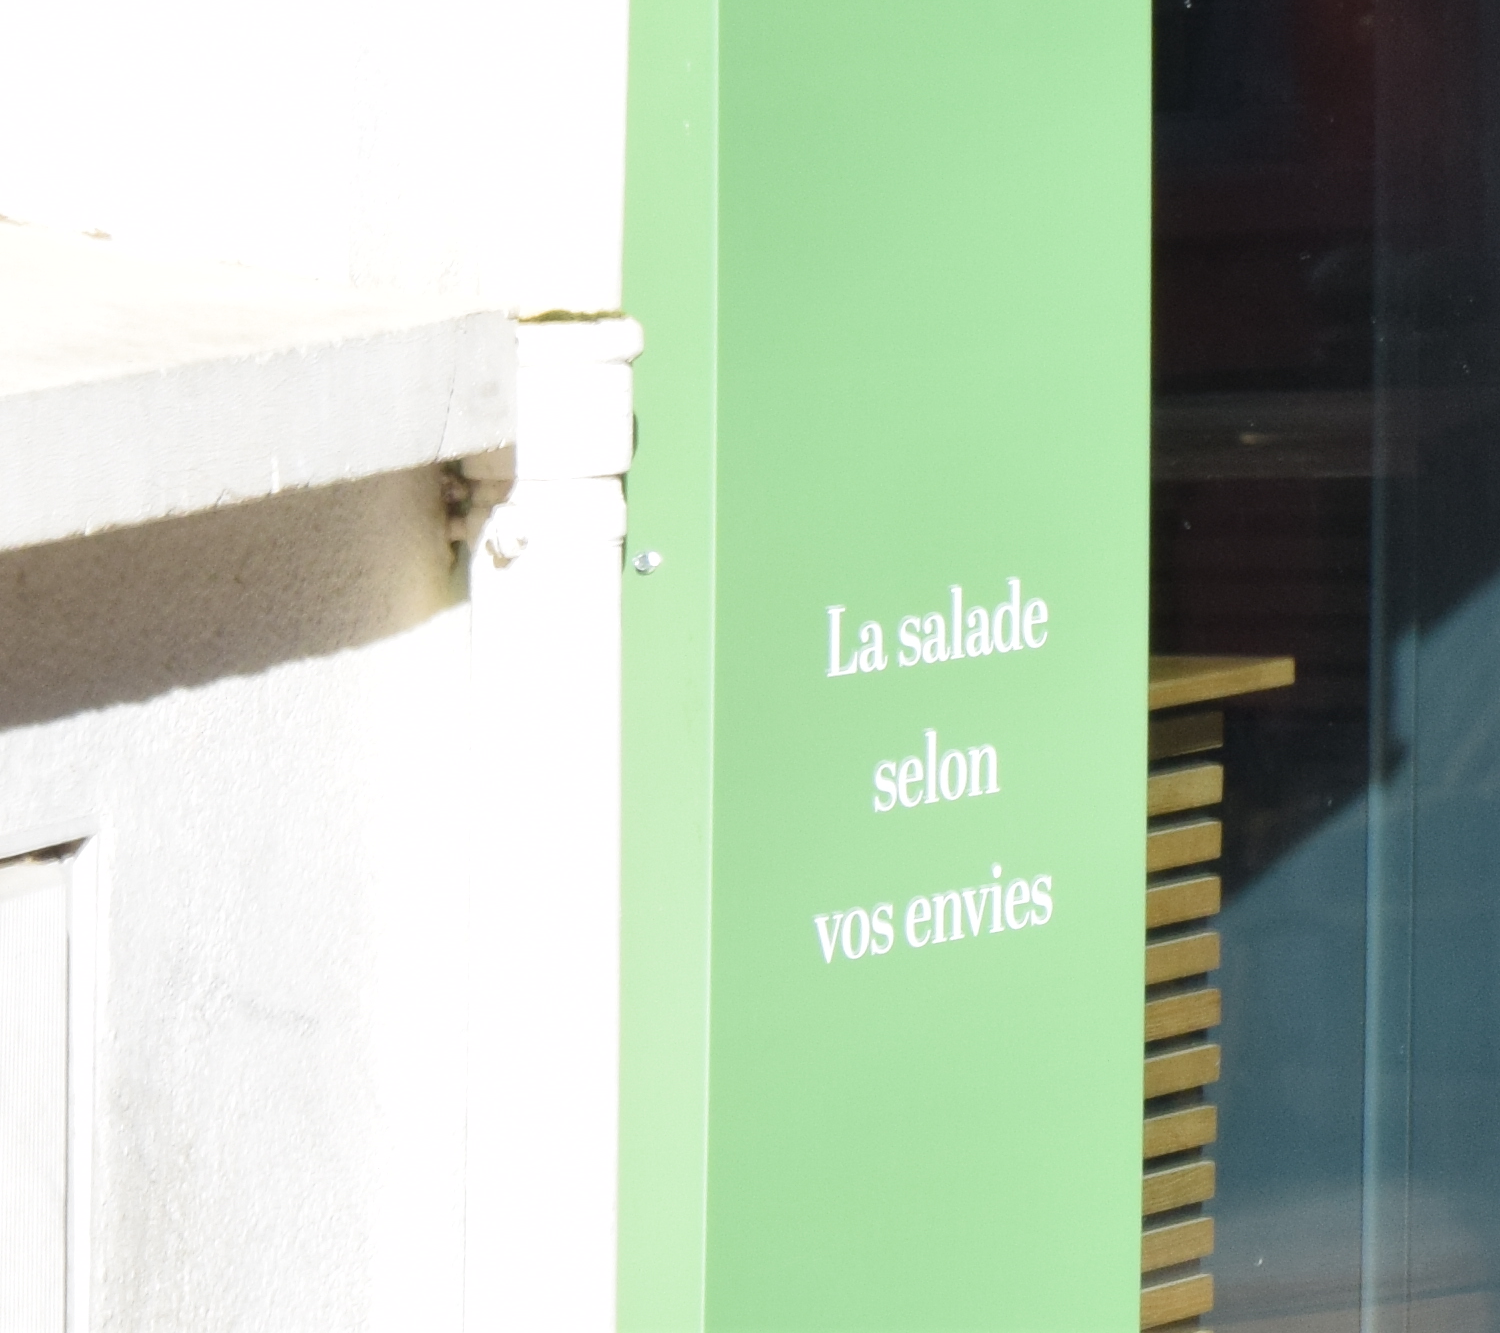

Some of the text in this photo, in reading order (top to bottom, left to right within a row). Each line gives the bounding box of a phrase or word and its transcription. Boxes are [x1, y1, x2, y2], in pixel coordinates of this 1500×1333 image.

[825, 576, 1049, 677] La salade
[873, 727, 1000, 812] selon
[813, 862, 1053, 963] vos envies
